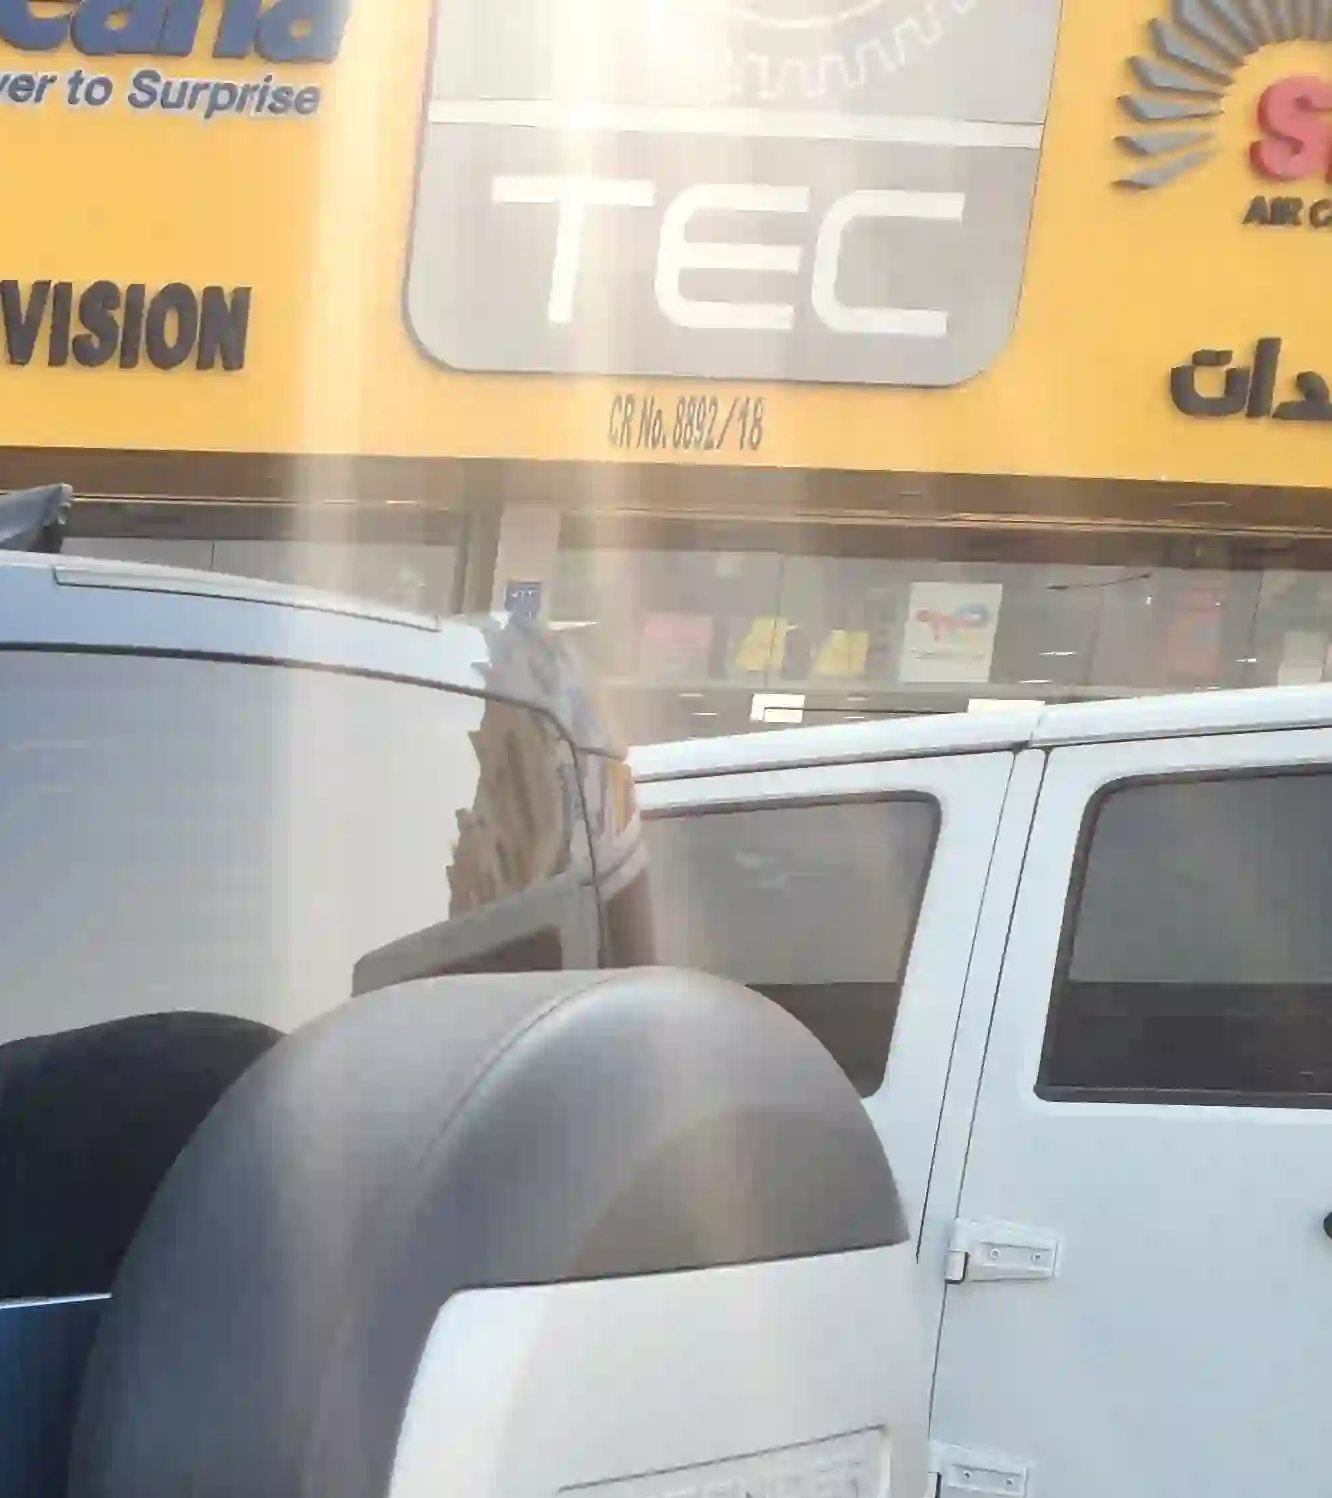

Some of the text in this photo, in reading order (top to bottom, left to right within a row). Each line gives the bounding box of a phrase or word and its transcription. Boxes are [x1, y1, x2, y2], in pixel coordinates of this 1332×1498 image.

[66, 66, 114, 107] to
[126, 69, 321, 120] Surprise
[1241, 195, 1304, 227] AIR
[492, 176, 965, 336] TEC
[609, 393, 635, 448] CR
[636, 394, 667, 449] No.
